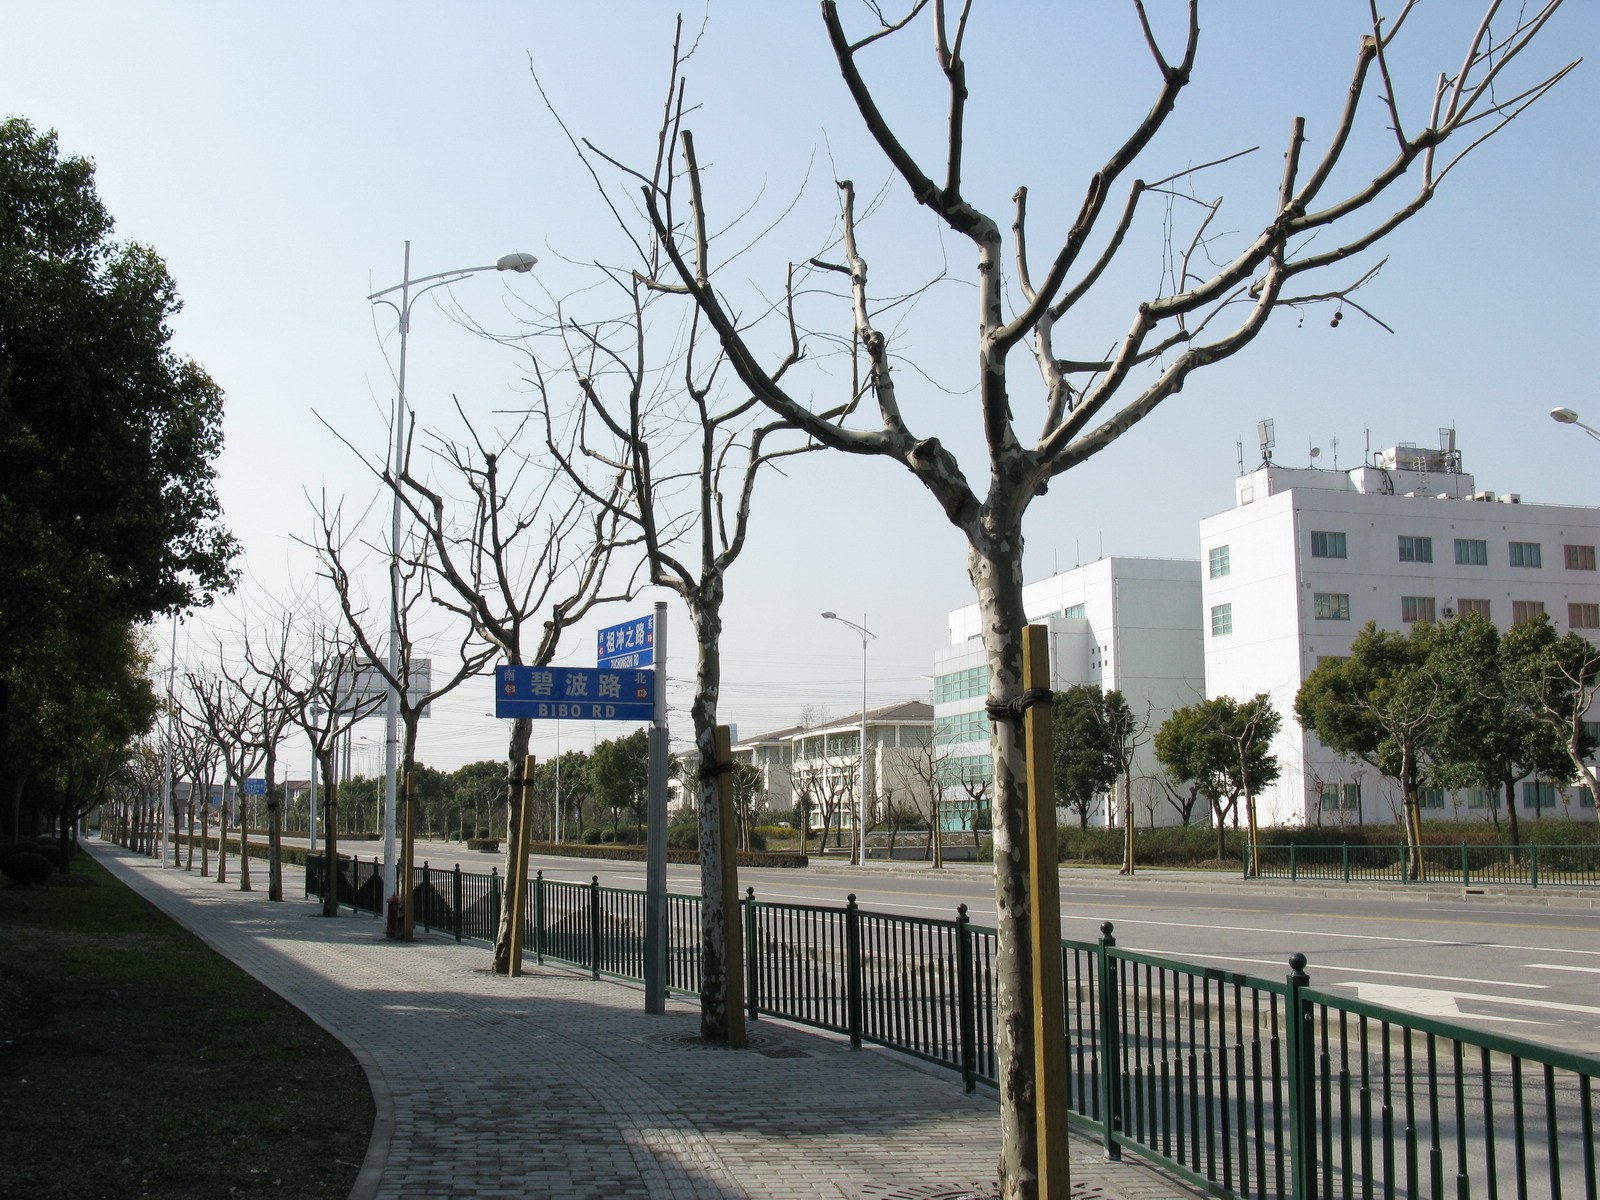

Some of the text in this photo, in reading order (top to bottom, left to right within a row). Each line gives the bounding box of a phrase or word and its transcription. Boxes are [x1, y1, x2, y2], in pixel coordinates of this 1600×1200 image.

[606, 622, 644, 653] 祖冲之路
[504, 670, 516, 682] 南
[634, 672, 646, 684] 北
[530, 672, 621, 698] 碧波路
[538, 704, 615, 718] BIBO RD
